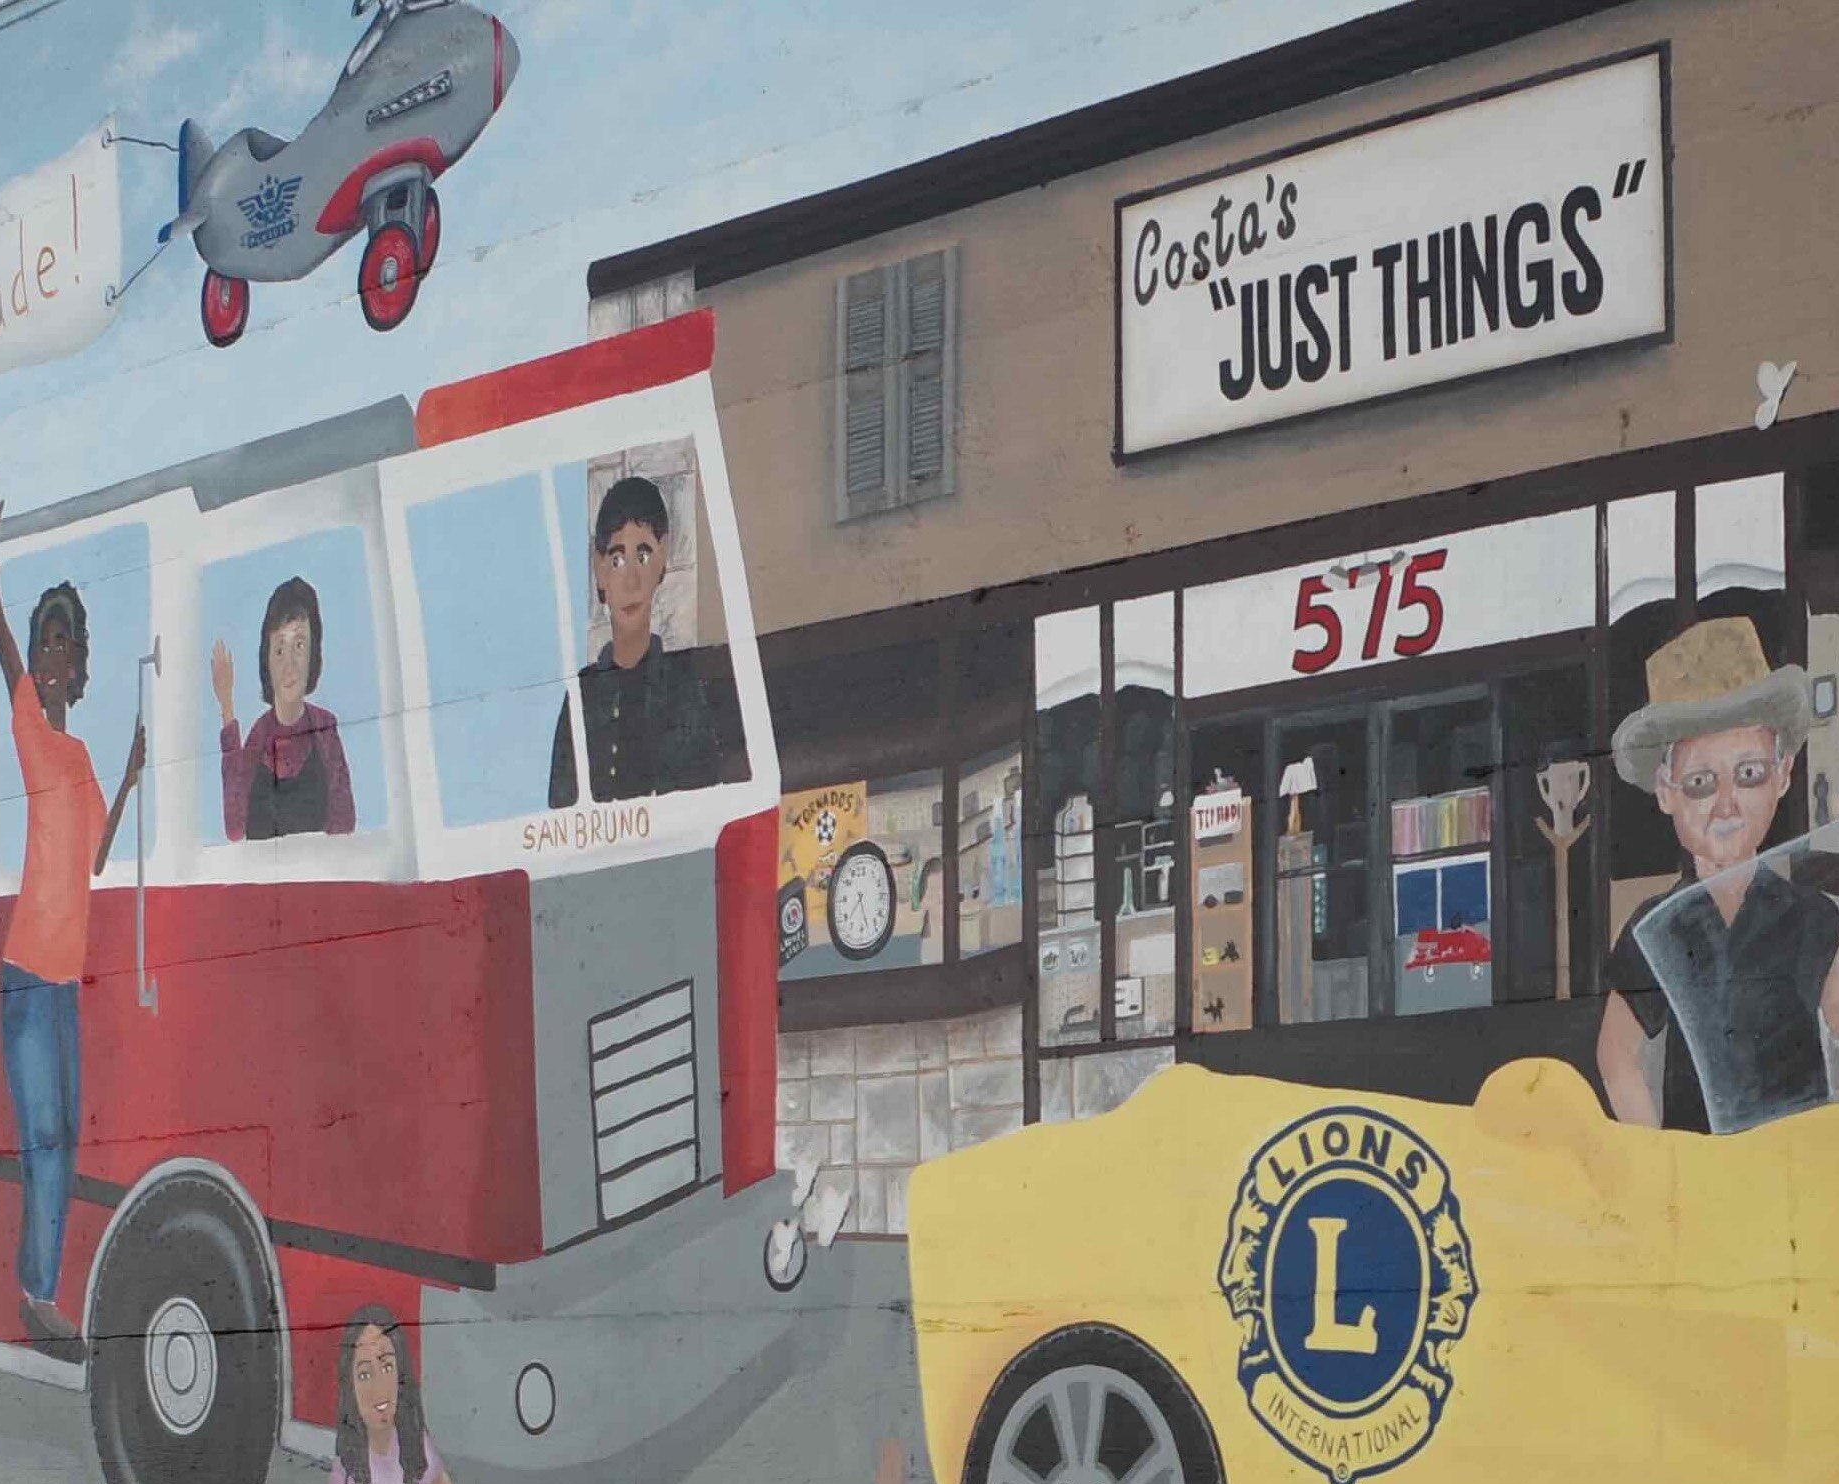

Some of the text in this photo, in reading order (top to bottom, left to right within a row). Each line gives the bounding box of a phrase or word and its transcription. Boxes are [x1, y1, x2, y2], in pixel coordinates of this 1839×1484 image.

[1134, 174, 1298, 307] Costa's
[1209, 158, 1648, 401] "JUST THINGS"
[1292, 548, 1448, 674] 575
[522, 806, 650, 851] SAN BRUNO
[1268, 1121, 1427, 1190] LIONS
[1304, 1217, 1378, 1355] L
[1267, 1392, 1423, 1461] INTERNATIONAL
